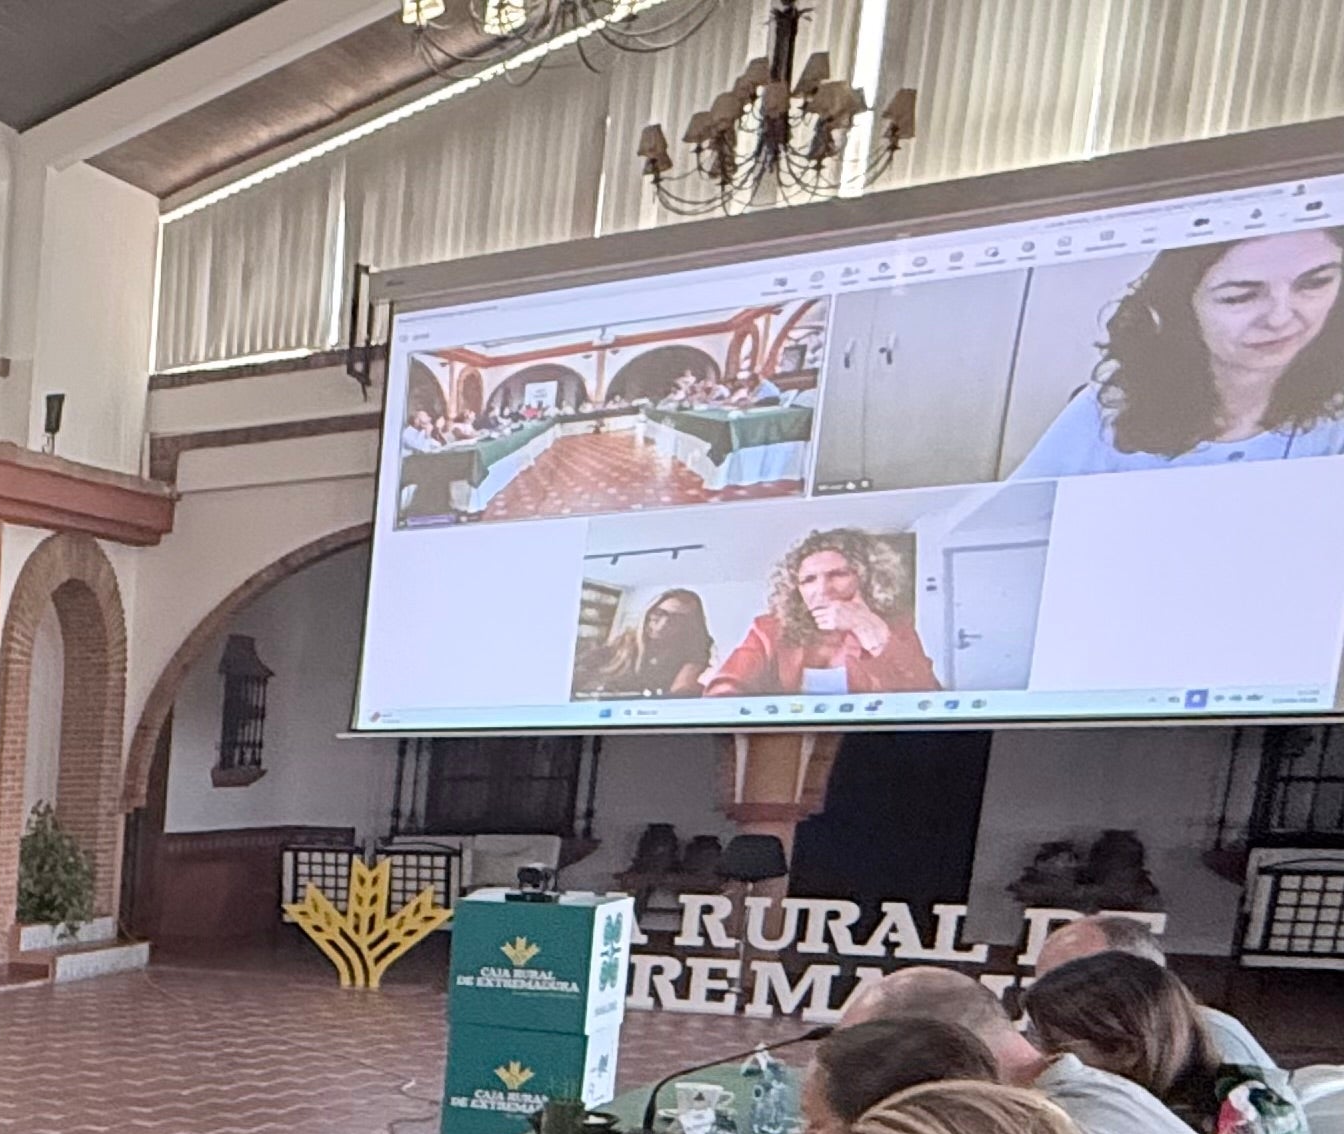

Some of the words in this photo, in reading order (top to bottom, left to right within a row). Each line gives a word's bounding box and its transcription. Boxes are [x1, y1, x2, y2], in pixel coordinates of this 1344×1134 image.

[674, 894, 989, 963] RURAL
[480, 967, 511, 978] CAJA
[512, 968, 556, 980] RURAL
[456, 975, 474, 986] DE
[476, 976, 580, 993] EXTREMADURA
[450, 1096, 469, 1108] DE
[474, 1089, 505, 1101] CAJA
[507, 1091, 550, 1103] RURA
